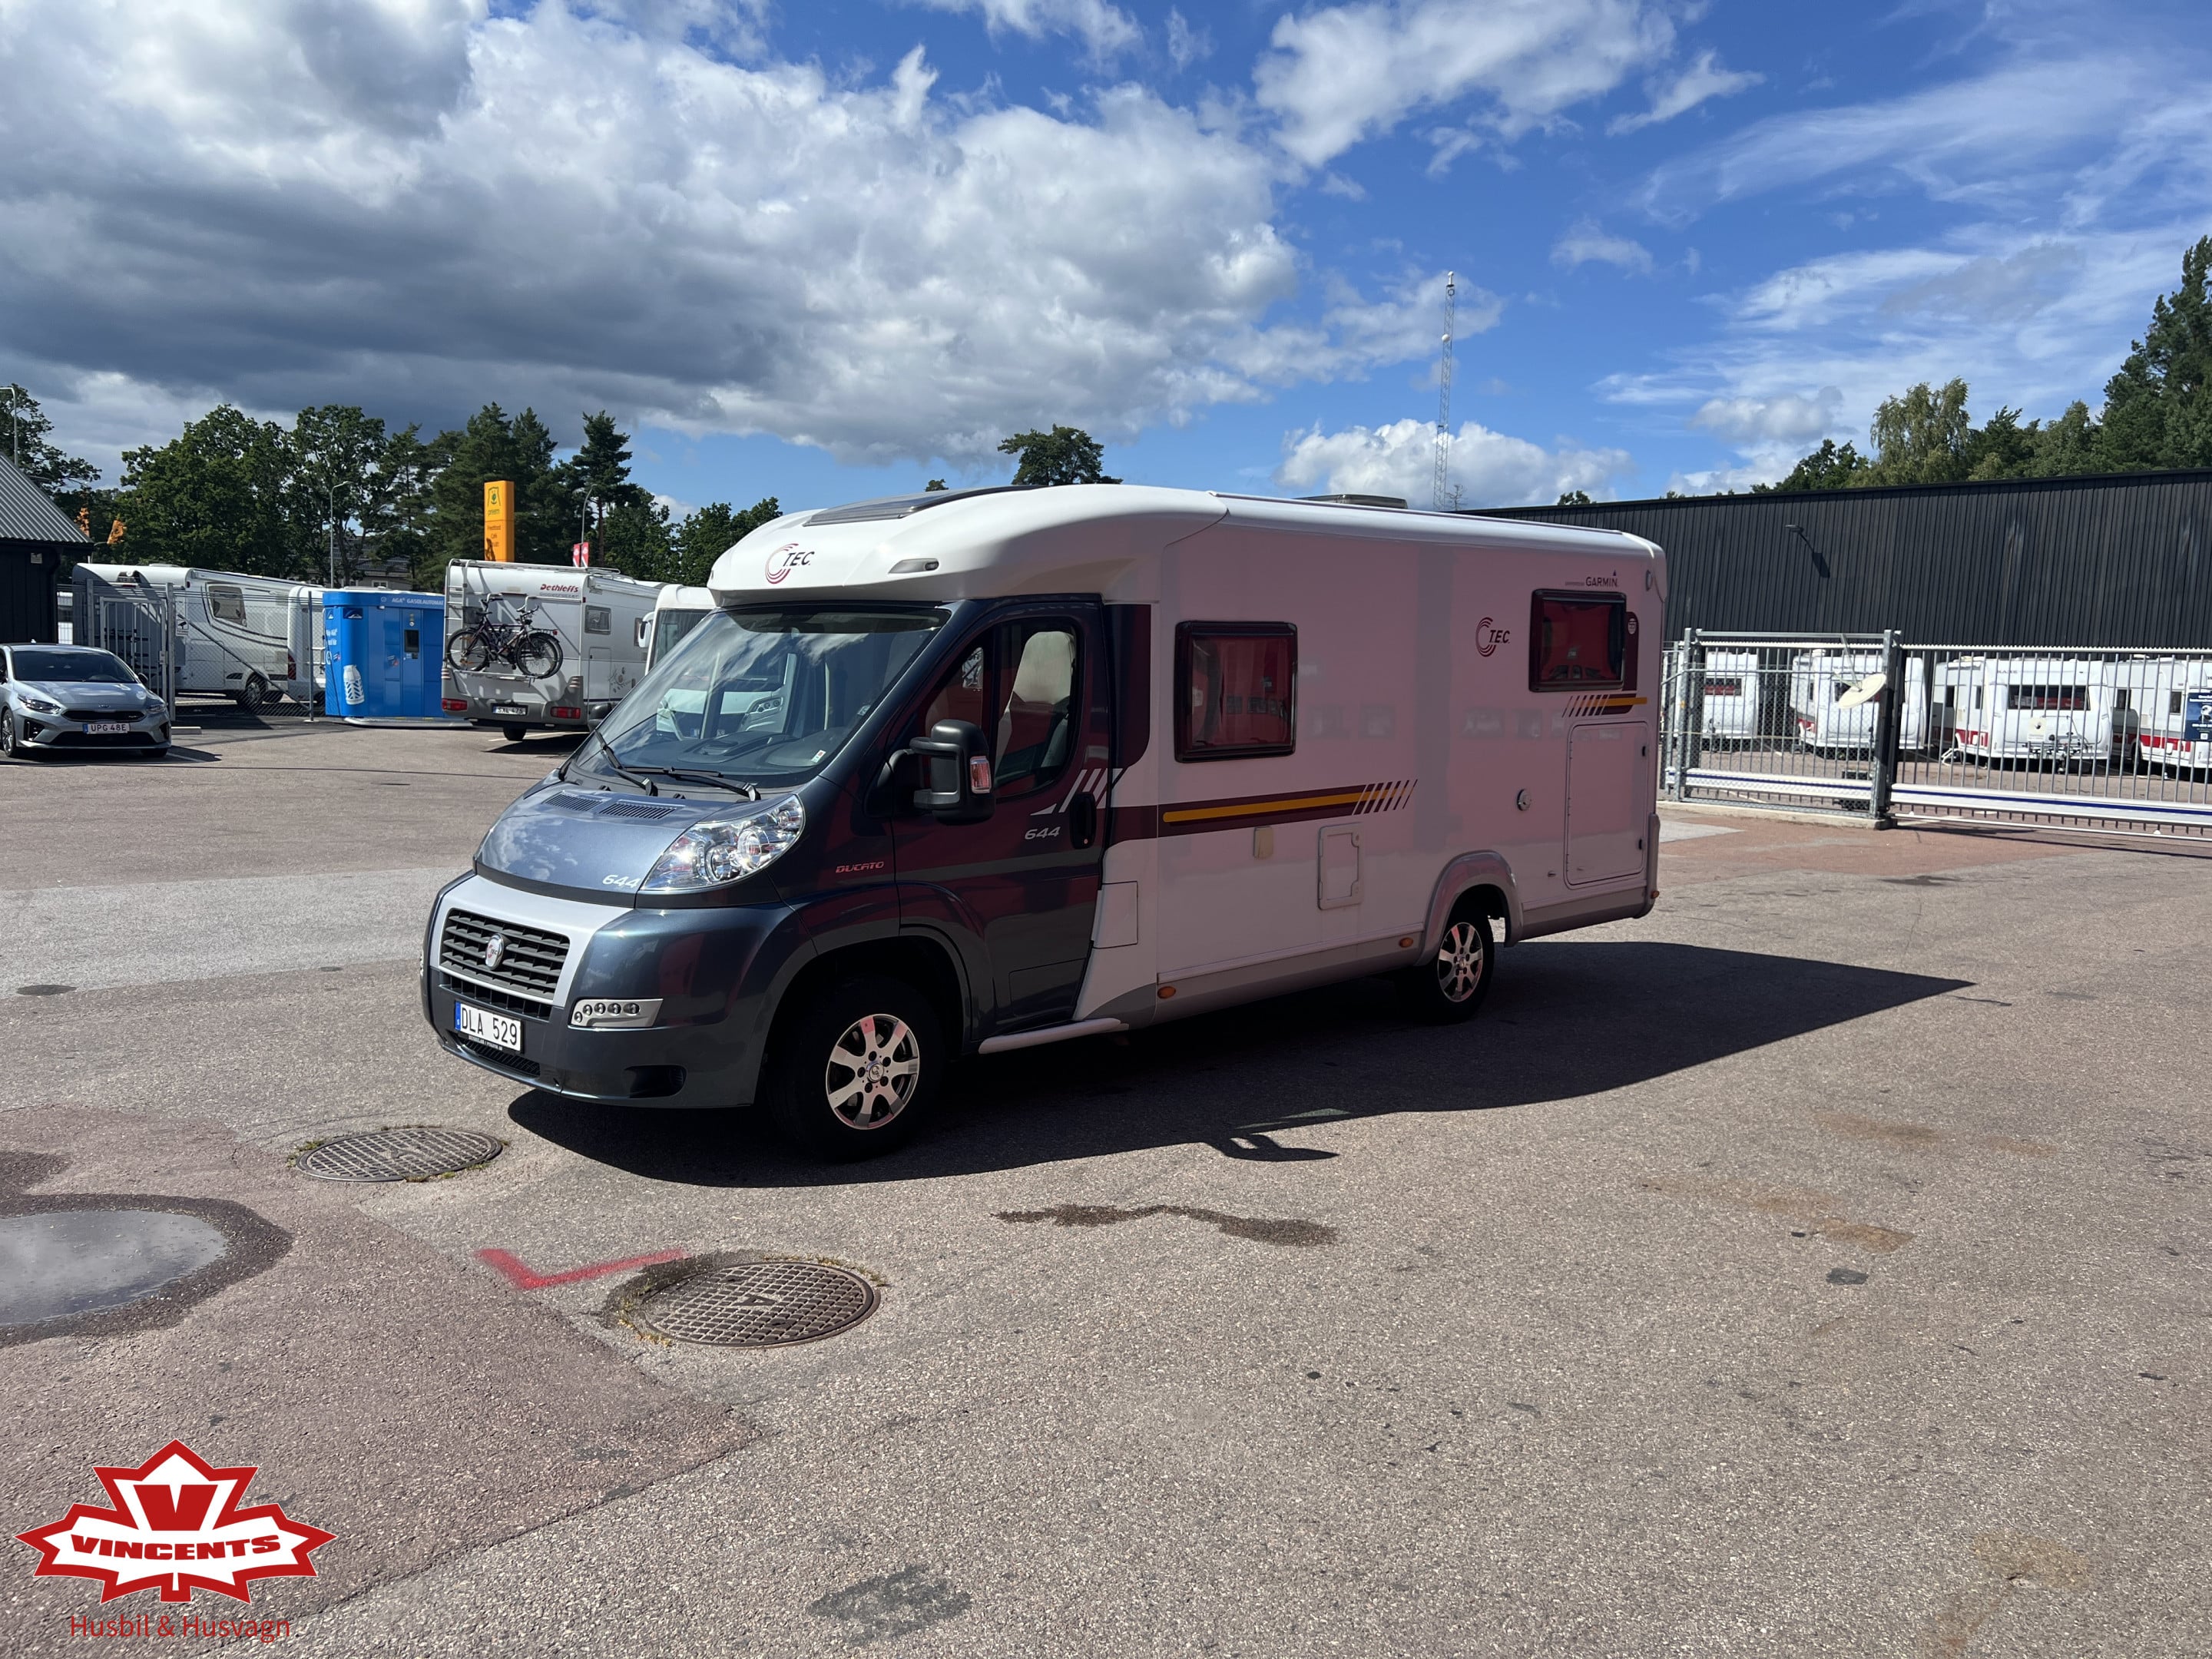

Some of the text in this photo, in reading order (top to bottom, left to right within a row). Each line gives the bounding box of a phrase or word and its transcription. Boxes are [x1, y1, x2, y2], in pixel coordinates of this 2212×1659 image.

[540, 584, 579, 592] Dethleffs
[1585, 577, 1618, 587] GARMIN
[1025, 826, 1061, 839] 644
[836, 861, 884, 873] DUCATO
[602, 874, 641, 888] 644
[462, 1007, 484, 1035] DLA
[492, 1017, 517, 1045] 529
